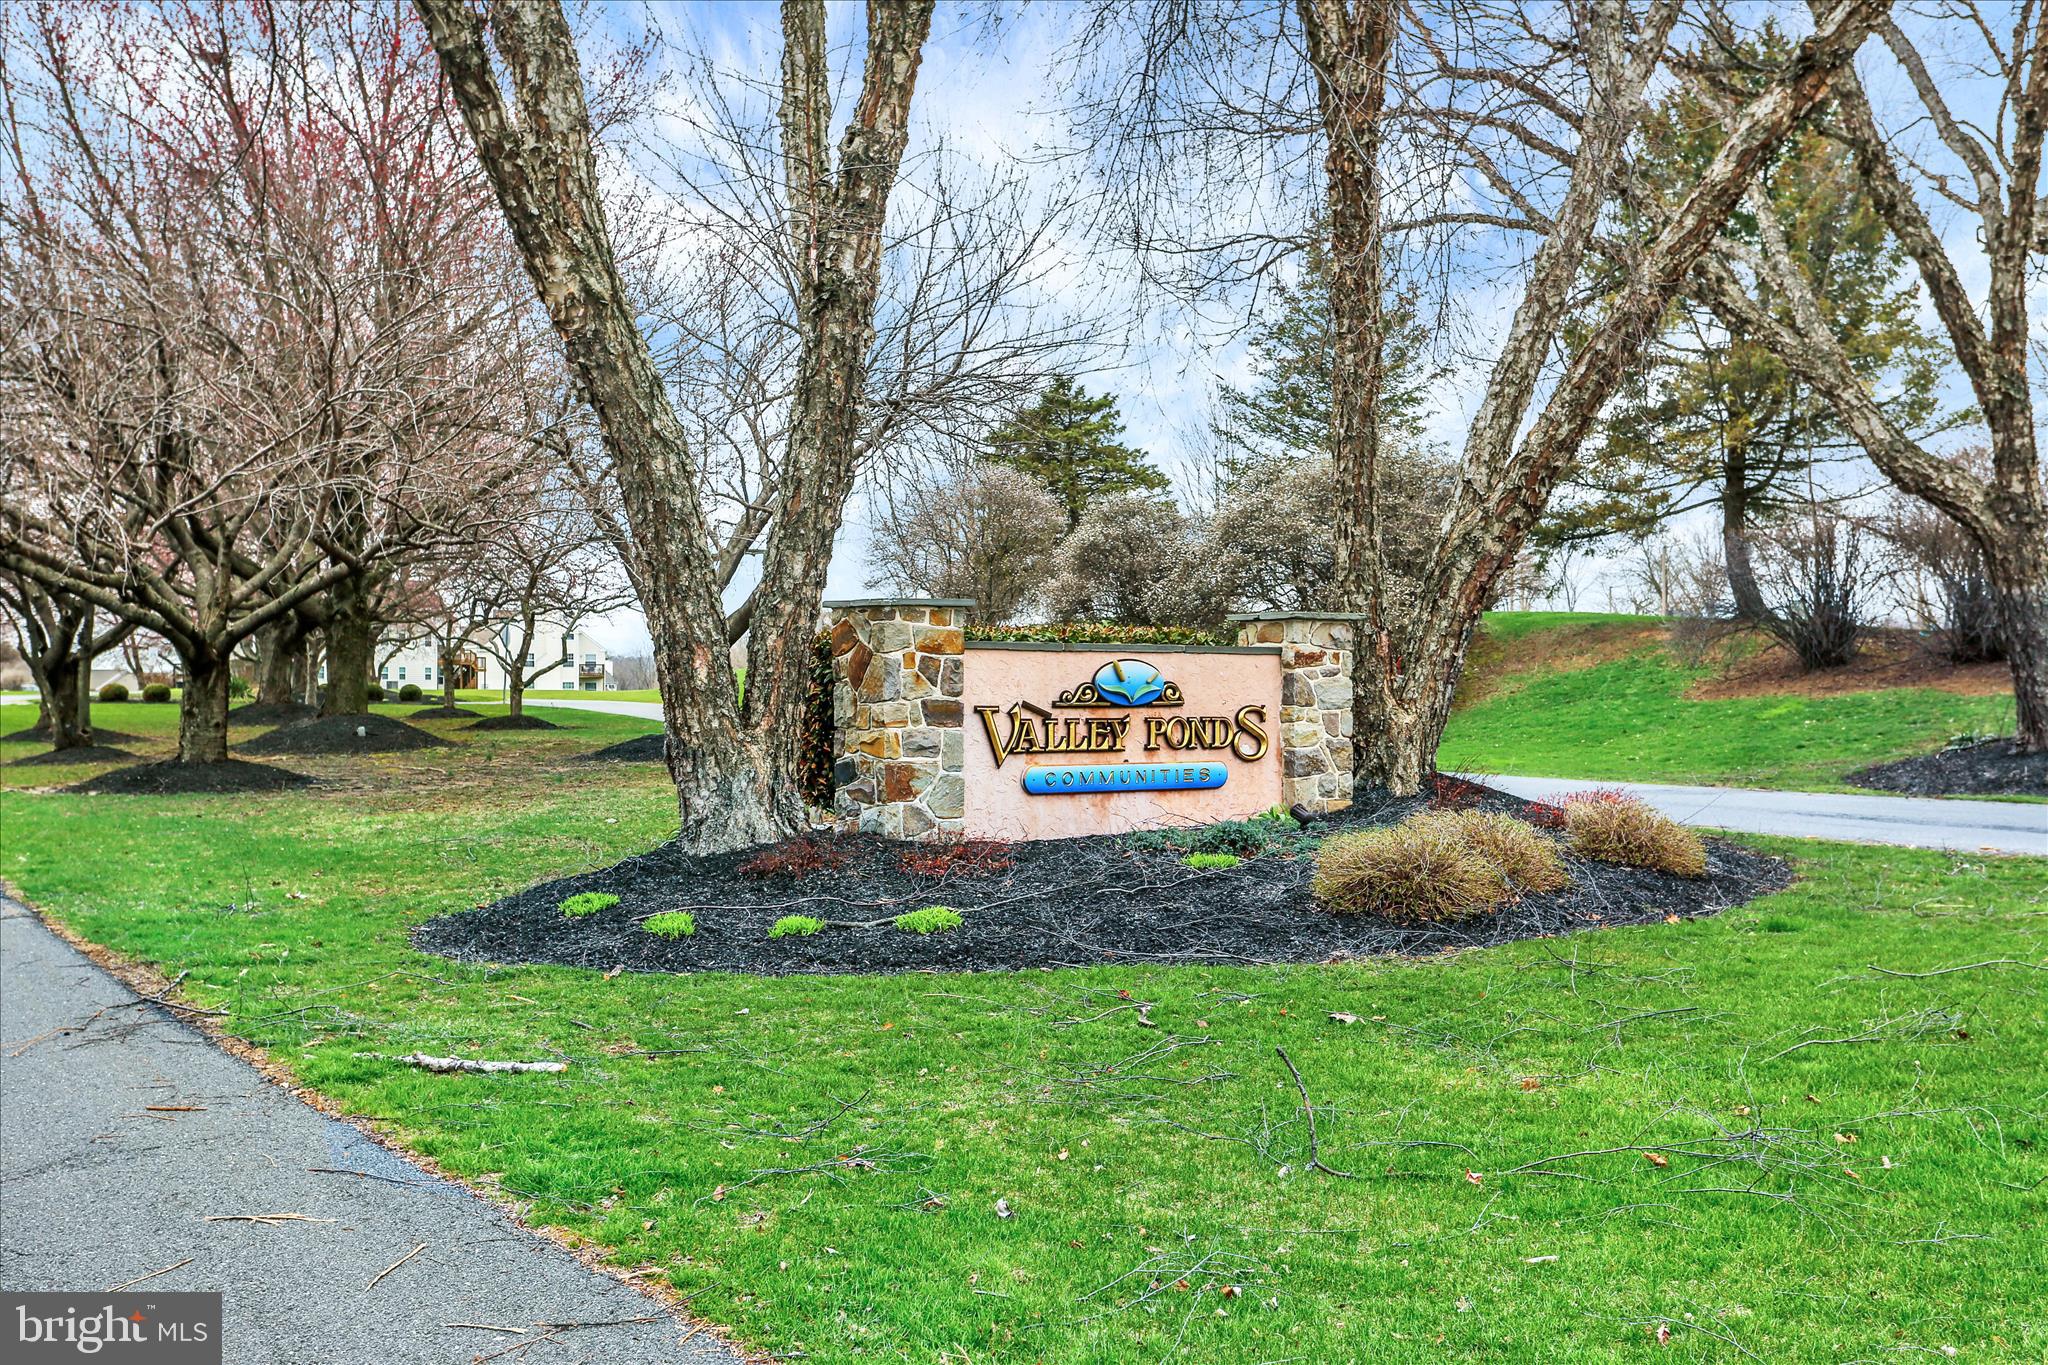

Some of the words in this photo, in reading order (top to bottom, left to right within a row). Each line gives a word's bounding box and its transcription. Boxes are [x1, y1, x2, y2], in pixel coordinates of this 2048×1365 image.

[974, 701, 1132, 769] VALLEY
[1145, 704, 1269, 762] PONDS
[1044, 767, 1211, 787] COMMUNITIES
